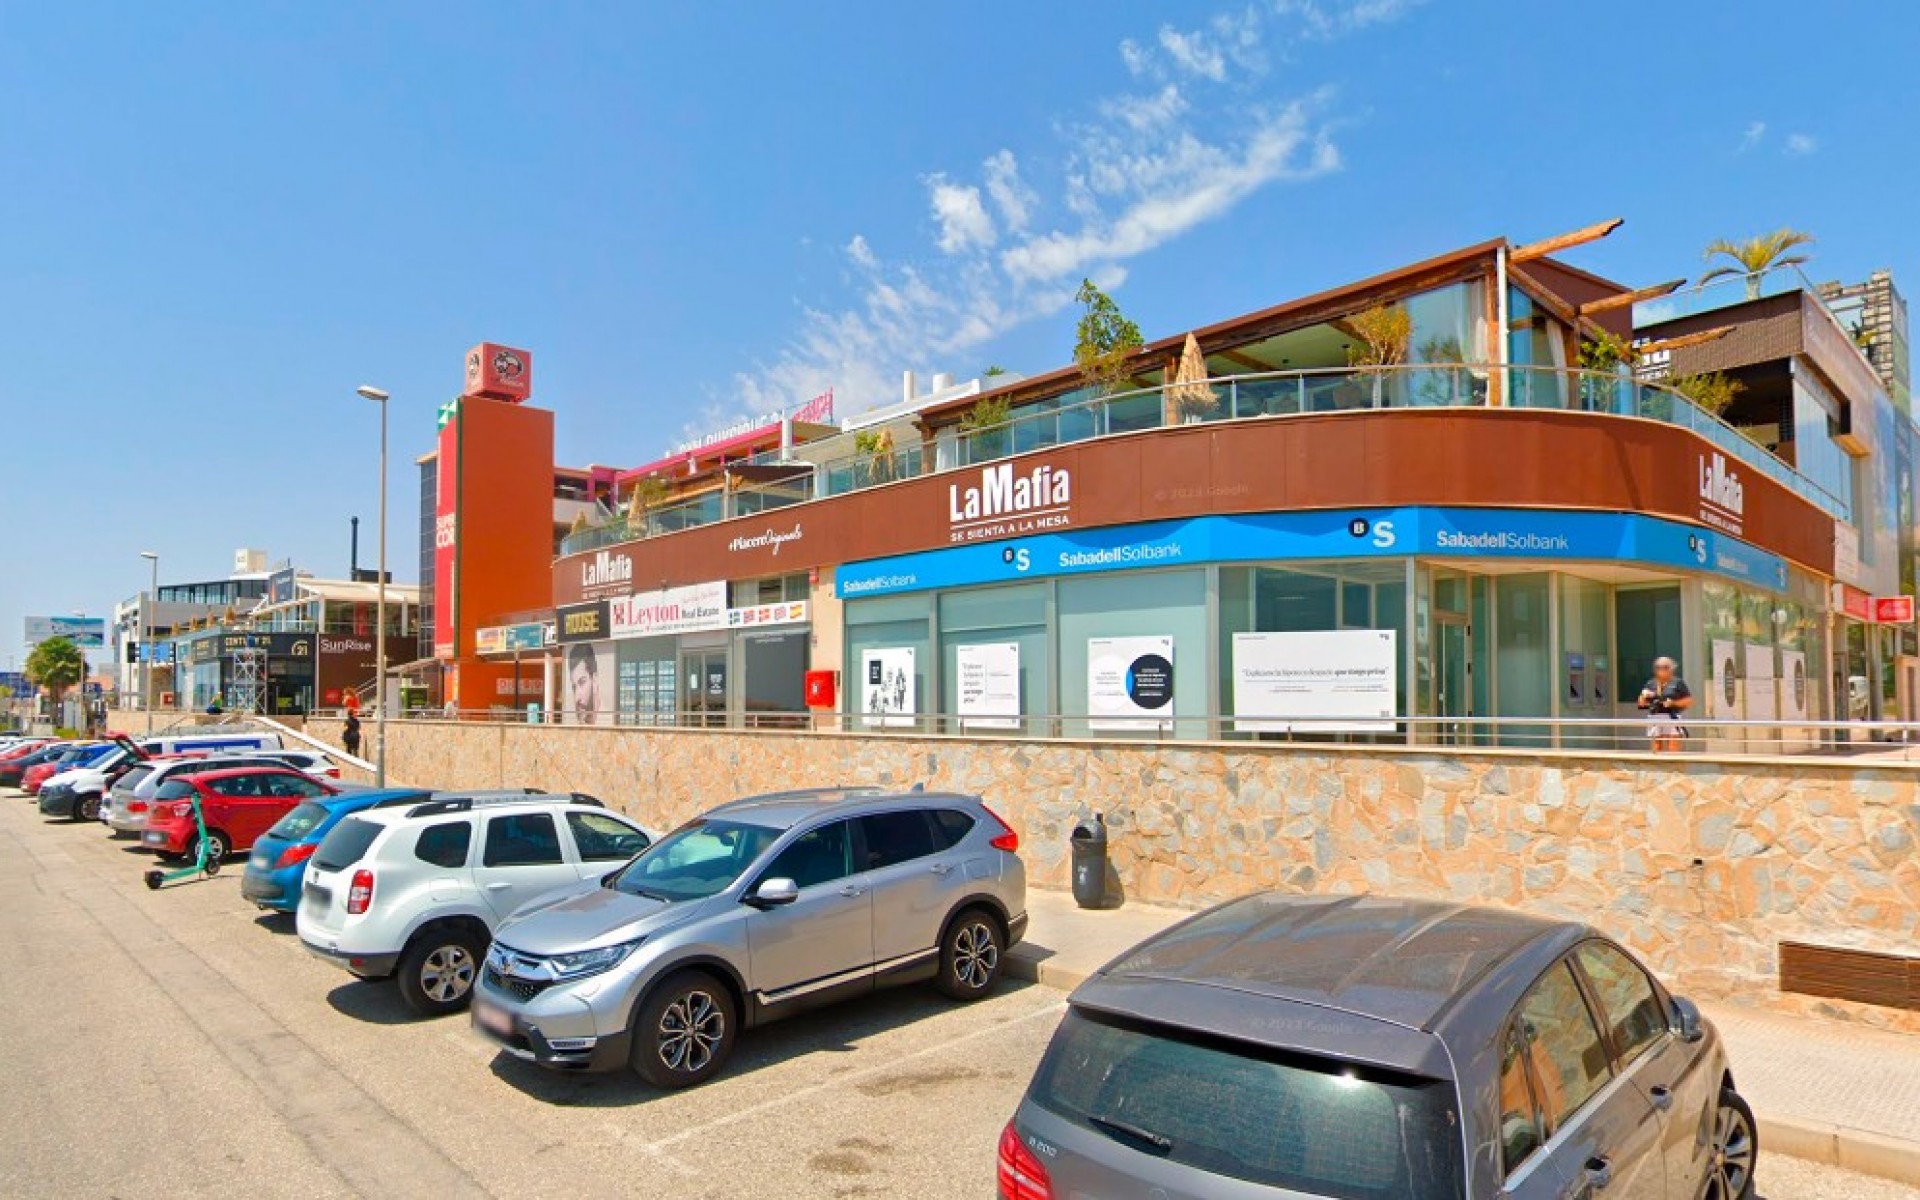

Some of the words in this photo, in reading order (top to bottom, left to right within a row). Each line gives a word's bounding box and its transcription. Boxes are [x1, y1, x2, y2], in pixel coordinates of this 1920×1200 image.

[950, 531, 964, 542] SE
[967, 525, 1006, 540] SIENTA
[1008, 523, 1016, 534] A
[1019, 521, 1034, 532] LA
[1036, 515, 1069, 529] MESA
[627, 600, 680, 627] Leyton
[320, 638, 372, 652] SunRise
